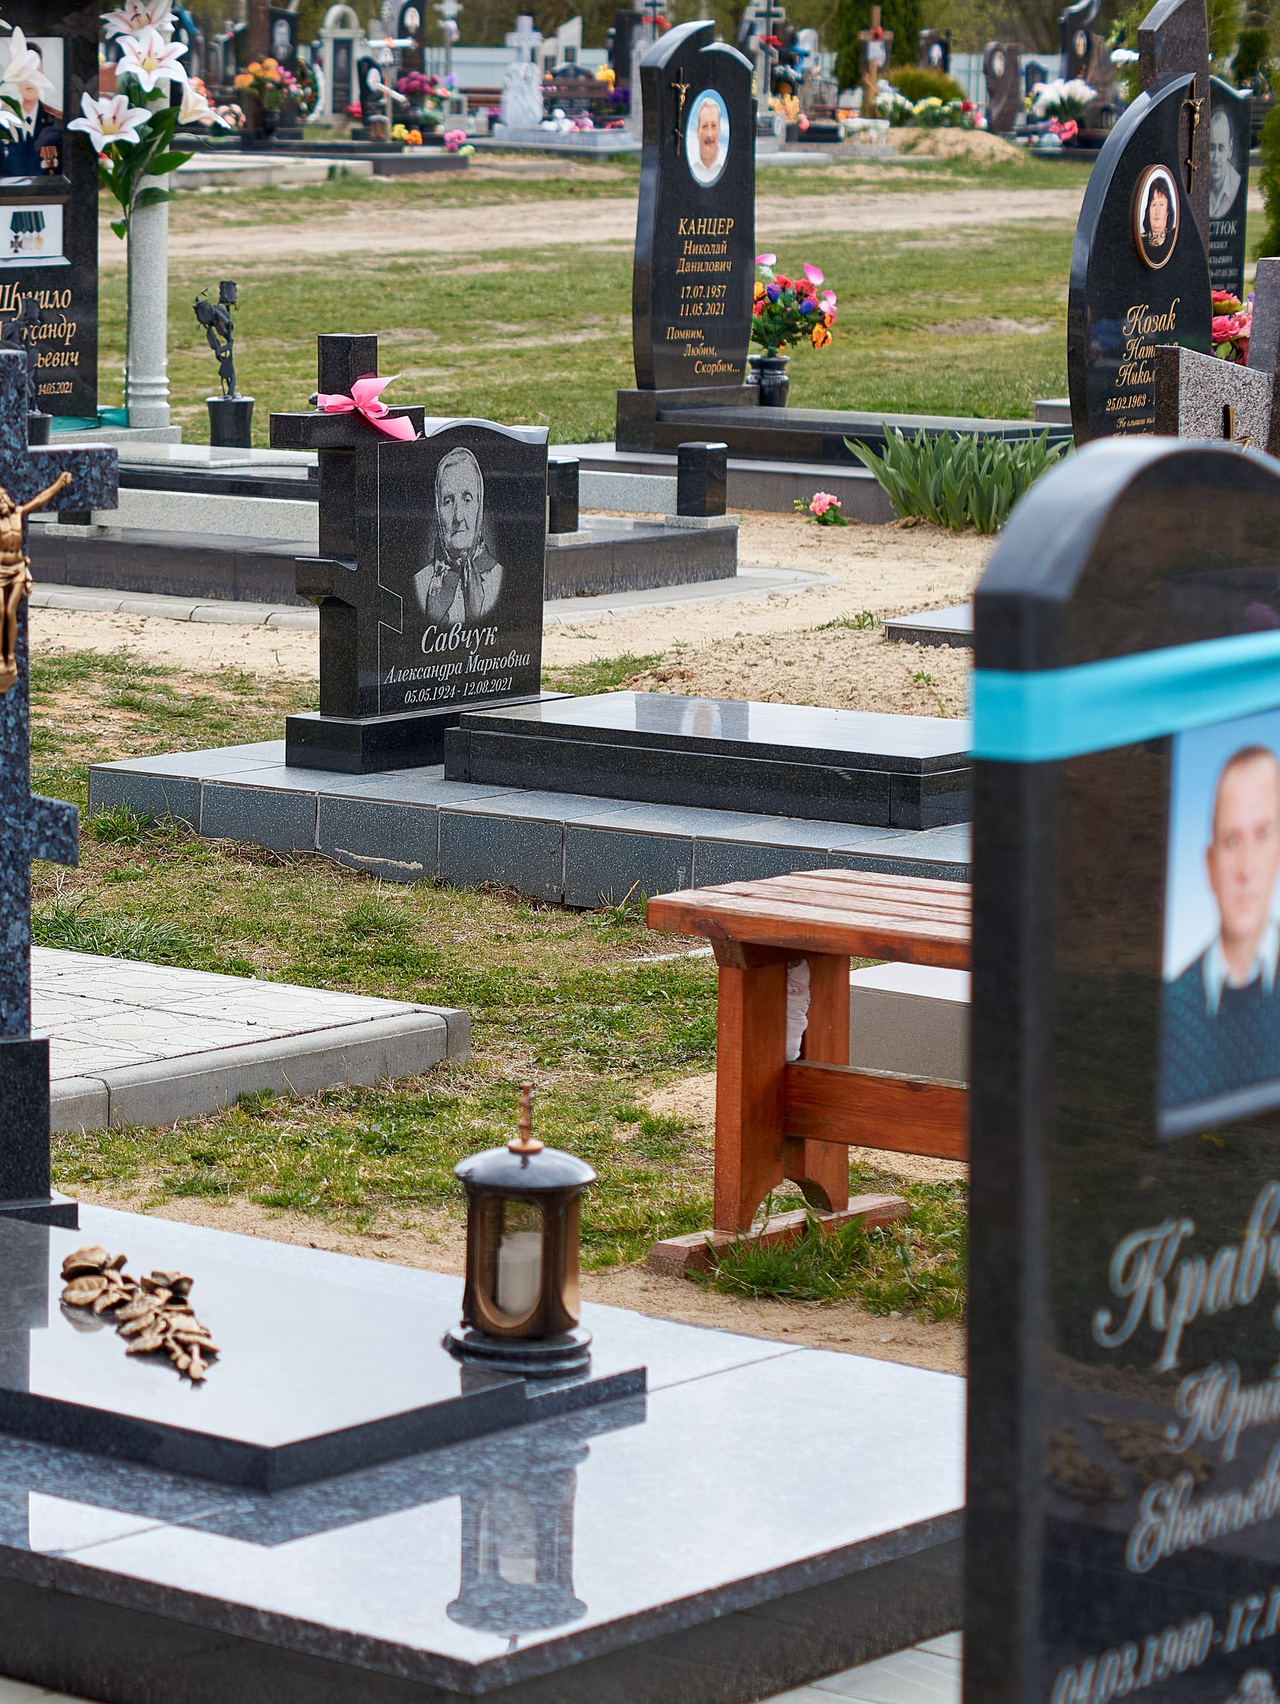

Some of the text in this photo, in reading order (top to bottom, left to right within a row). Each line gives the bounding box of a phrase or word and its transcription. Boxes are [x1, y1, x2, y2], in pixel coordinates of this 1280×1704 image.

[678, 217, 735, 236] КАНЦЕР
[683, 239, 728, 255] Николай
[676, 257, 732, 275] Данилович
[680, 285, 728, 299] 17.07.1957
[680, 302, 726, 317] 11.05.2021
[1122, 297, 1181, 336] Козак
[666, 326, 706, 341] Помним,
[683, 342, 718, 358] Любим,
[34, 351, 80, 368] ьевич
[694, 359, 742, 377] Скорбим...
[421, 621, 499, 655] Савчук
[383, 649, 531, 685] Александра Марковна
[404, 684, 457, 704] 05.05.1924
[462, 676, 514, 697] 12.08.2021
